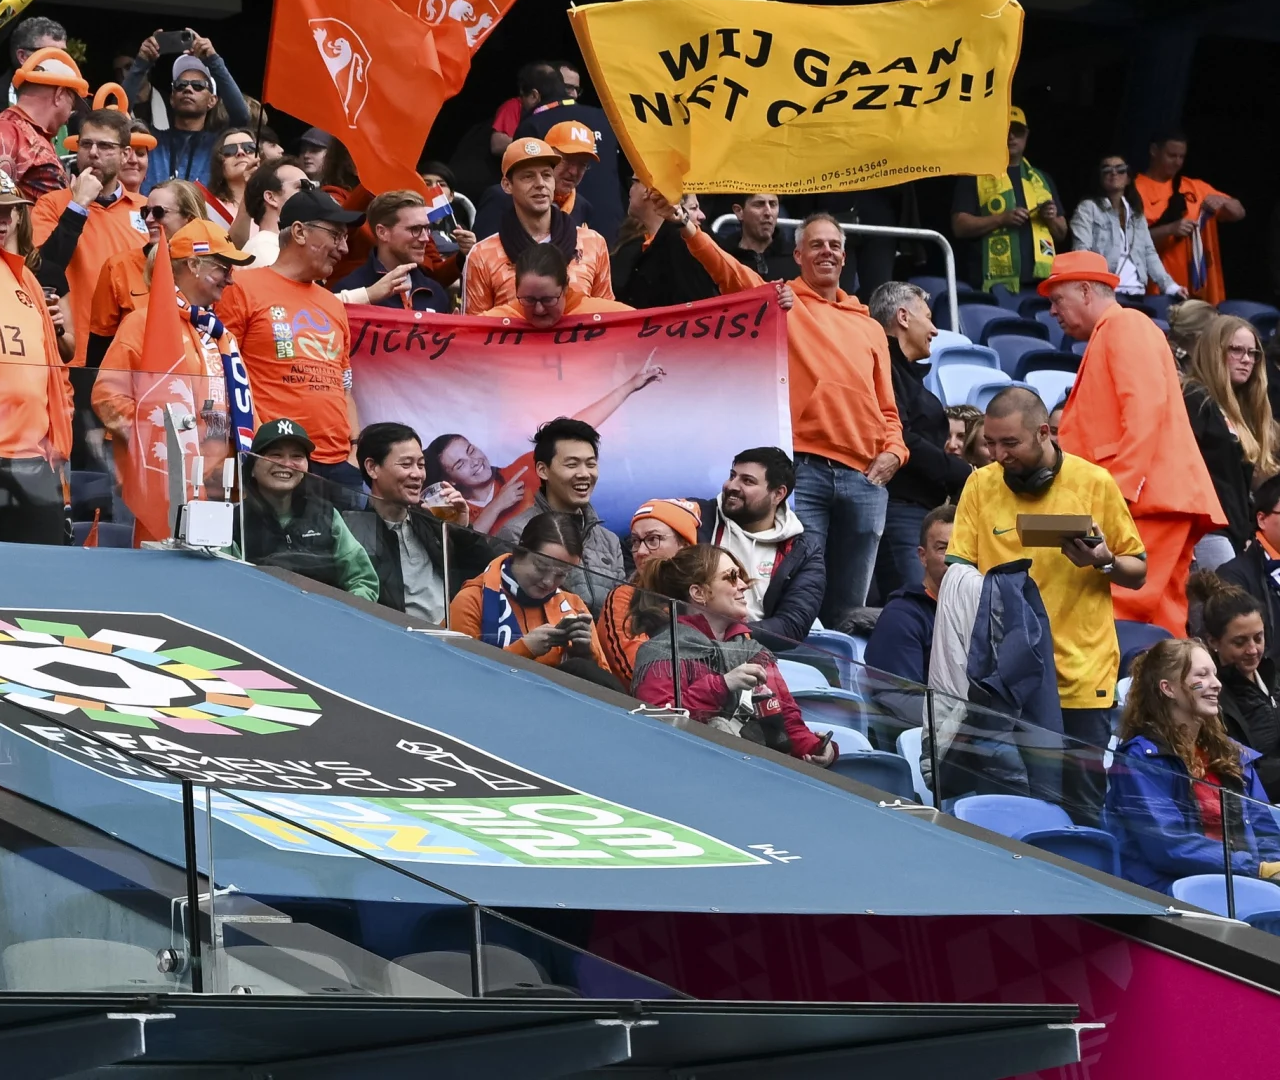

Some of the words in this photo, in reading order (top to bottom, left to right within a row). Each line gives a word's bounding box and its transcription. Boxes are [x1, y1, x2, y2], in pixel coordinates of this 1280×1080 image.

[658, 28, 773, 81] WIJ
[793, 36, 963, 88] GAAN
[628, 74, 749, 127] NIET
[766, 68, 995, 128] OPZIJ!!
[571, 127, 591, 144] NL
[821, 158, 889, 183] 076-5143649
[636, 301, 770, 340] basis!
[282, 375, 306, 384] NEW
[20, 724, 203, 754] FIFA
[60, 742, 373, 777] WOMEN'S
[336, 777, 458, 793] CUP
